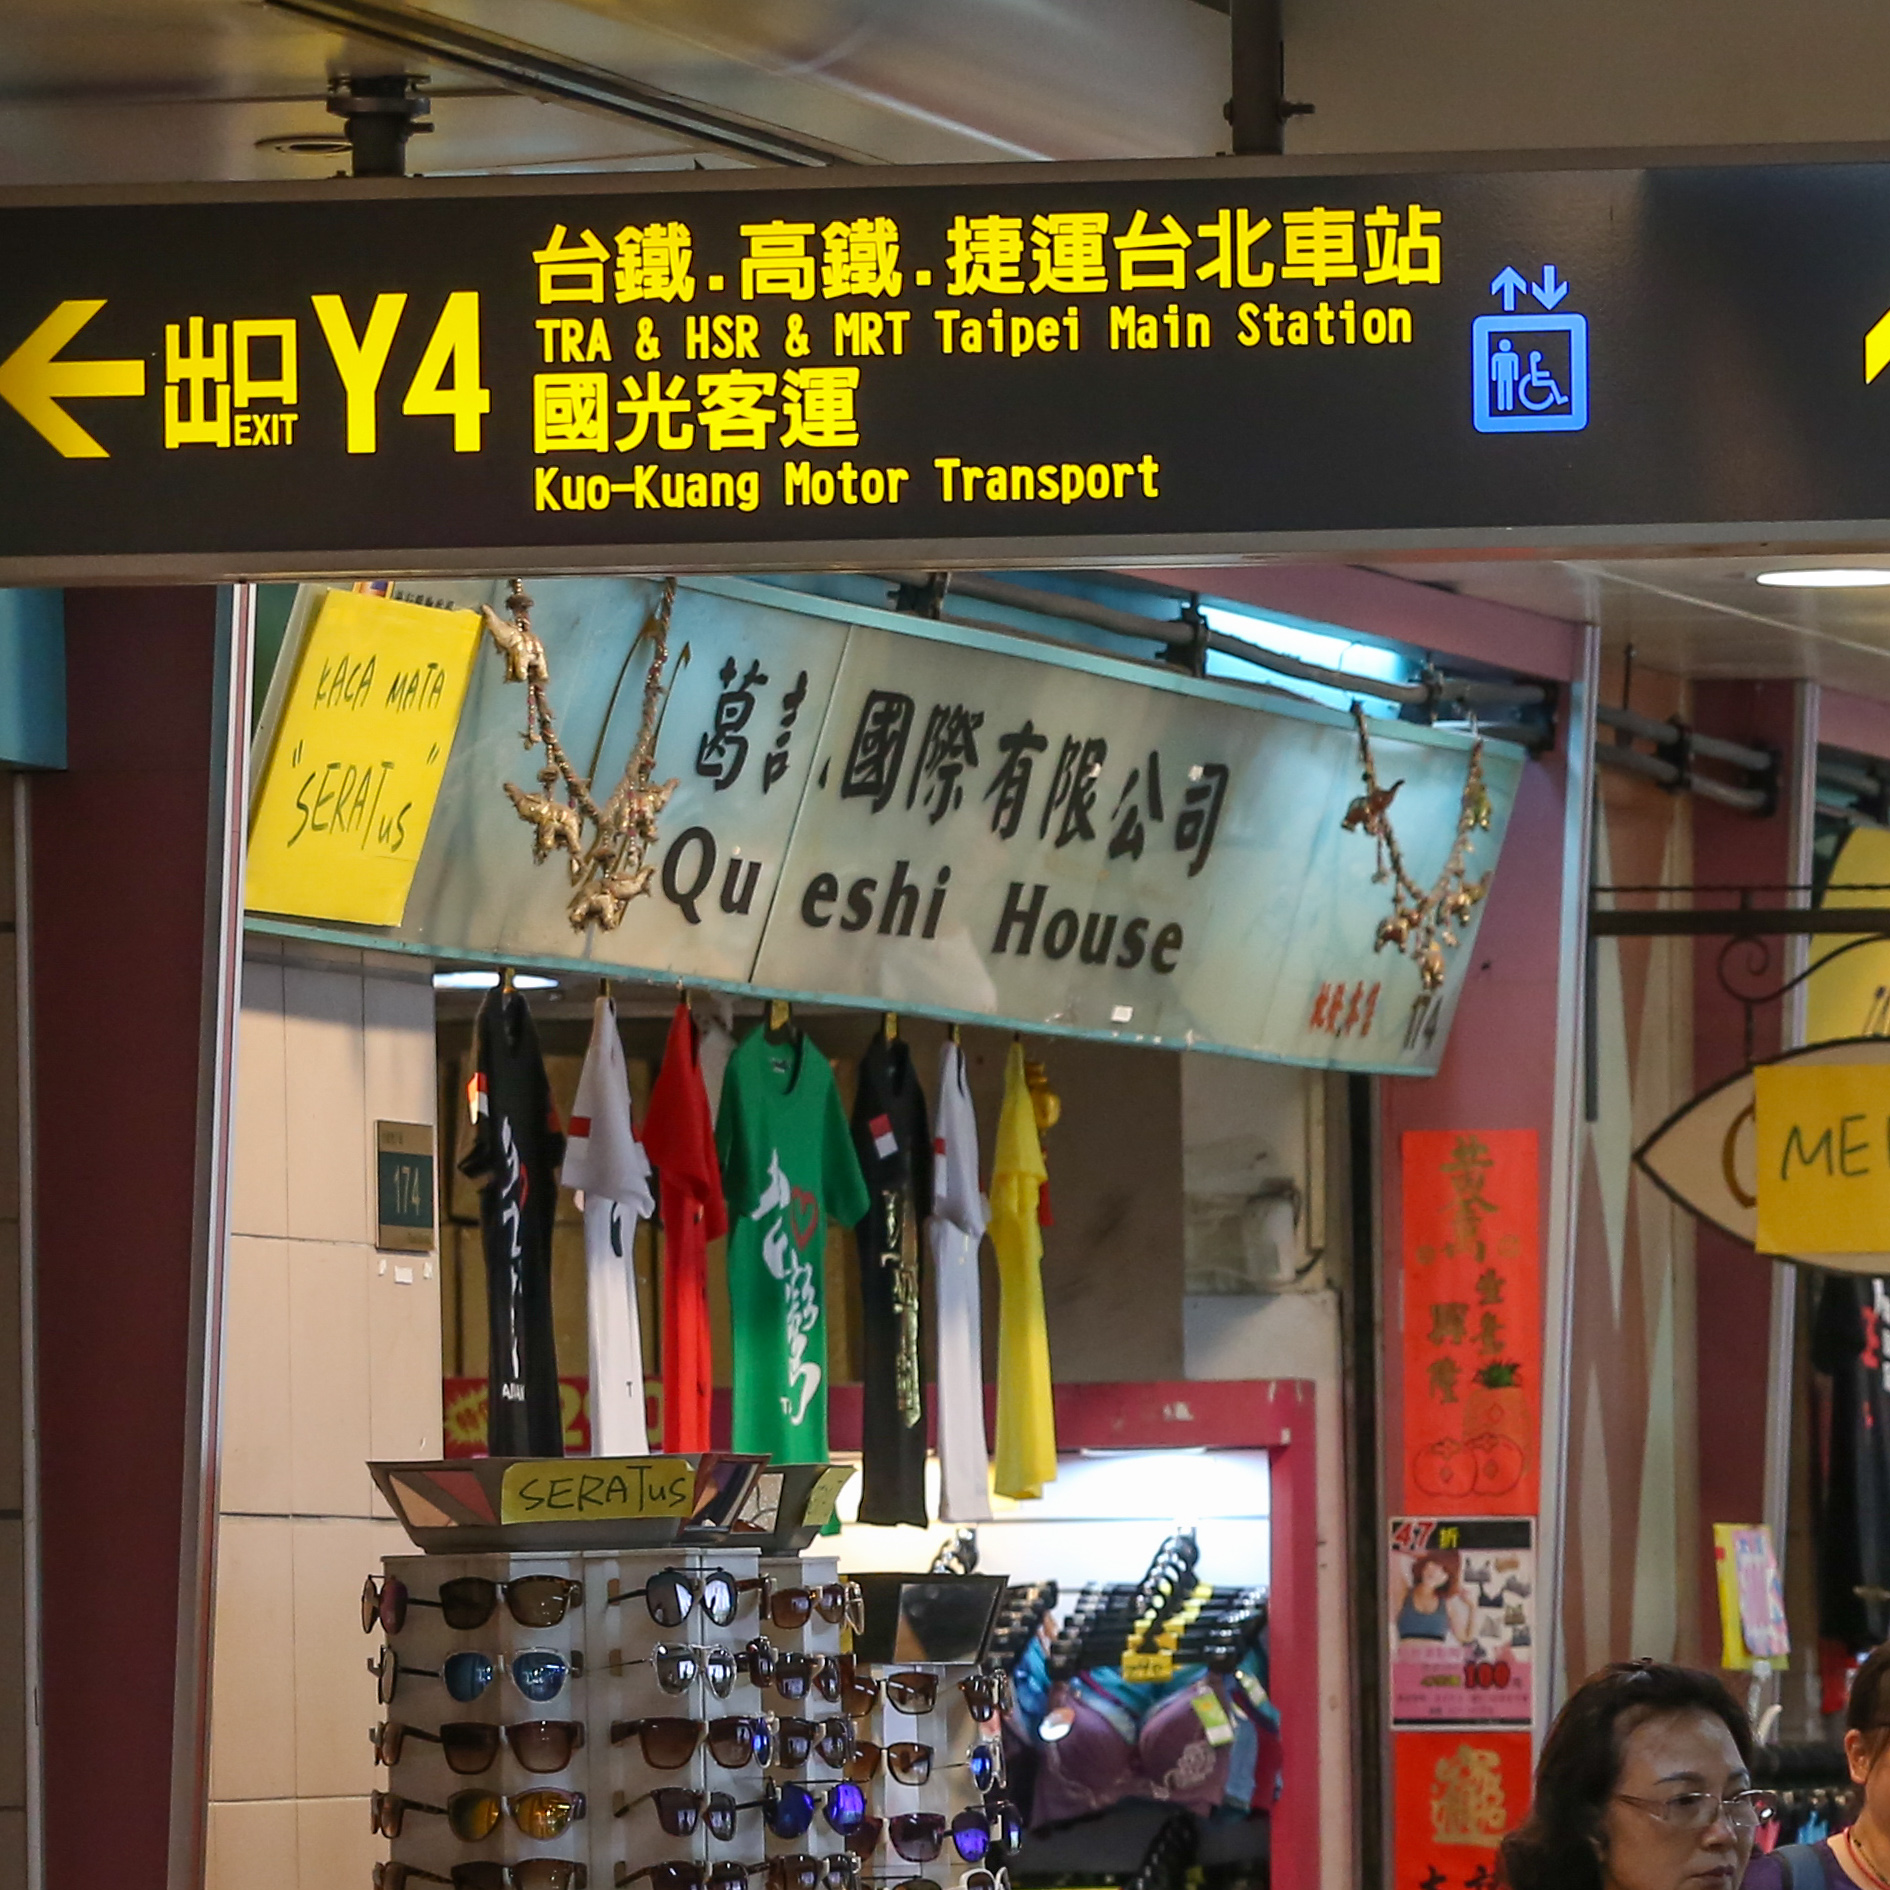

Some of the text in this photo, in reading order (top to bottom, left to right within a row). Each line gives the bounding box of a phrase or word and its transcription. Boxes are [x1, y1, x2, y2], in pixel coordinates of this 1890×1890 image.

[536, 300, 1411, 362] TRA & HSR & MRT Taipei Main Station
[165, 316, 298, 448] 出口
[311, 292, 490, 453] Y4
[234, 414, 298, 446] EXIT
[534, 367, 859, 453] 國光客運
[535, 455, 1158, 511] Kuo-Kuang Motor Transport
[314, 654, 445, 711] KACA MATA
[991, 881, 1183, 975] House
[393, 1165, 421, 1217] 174
